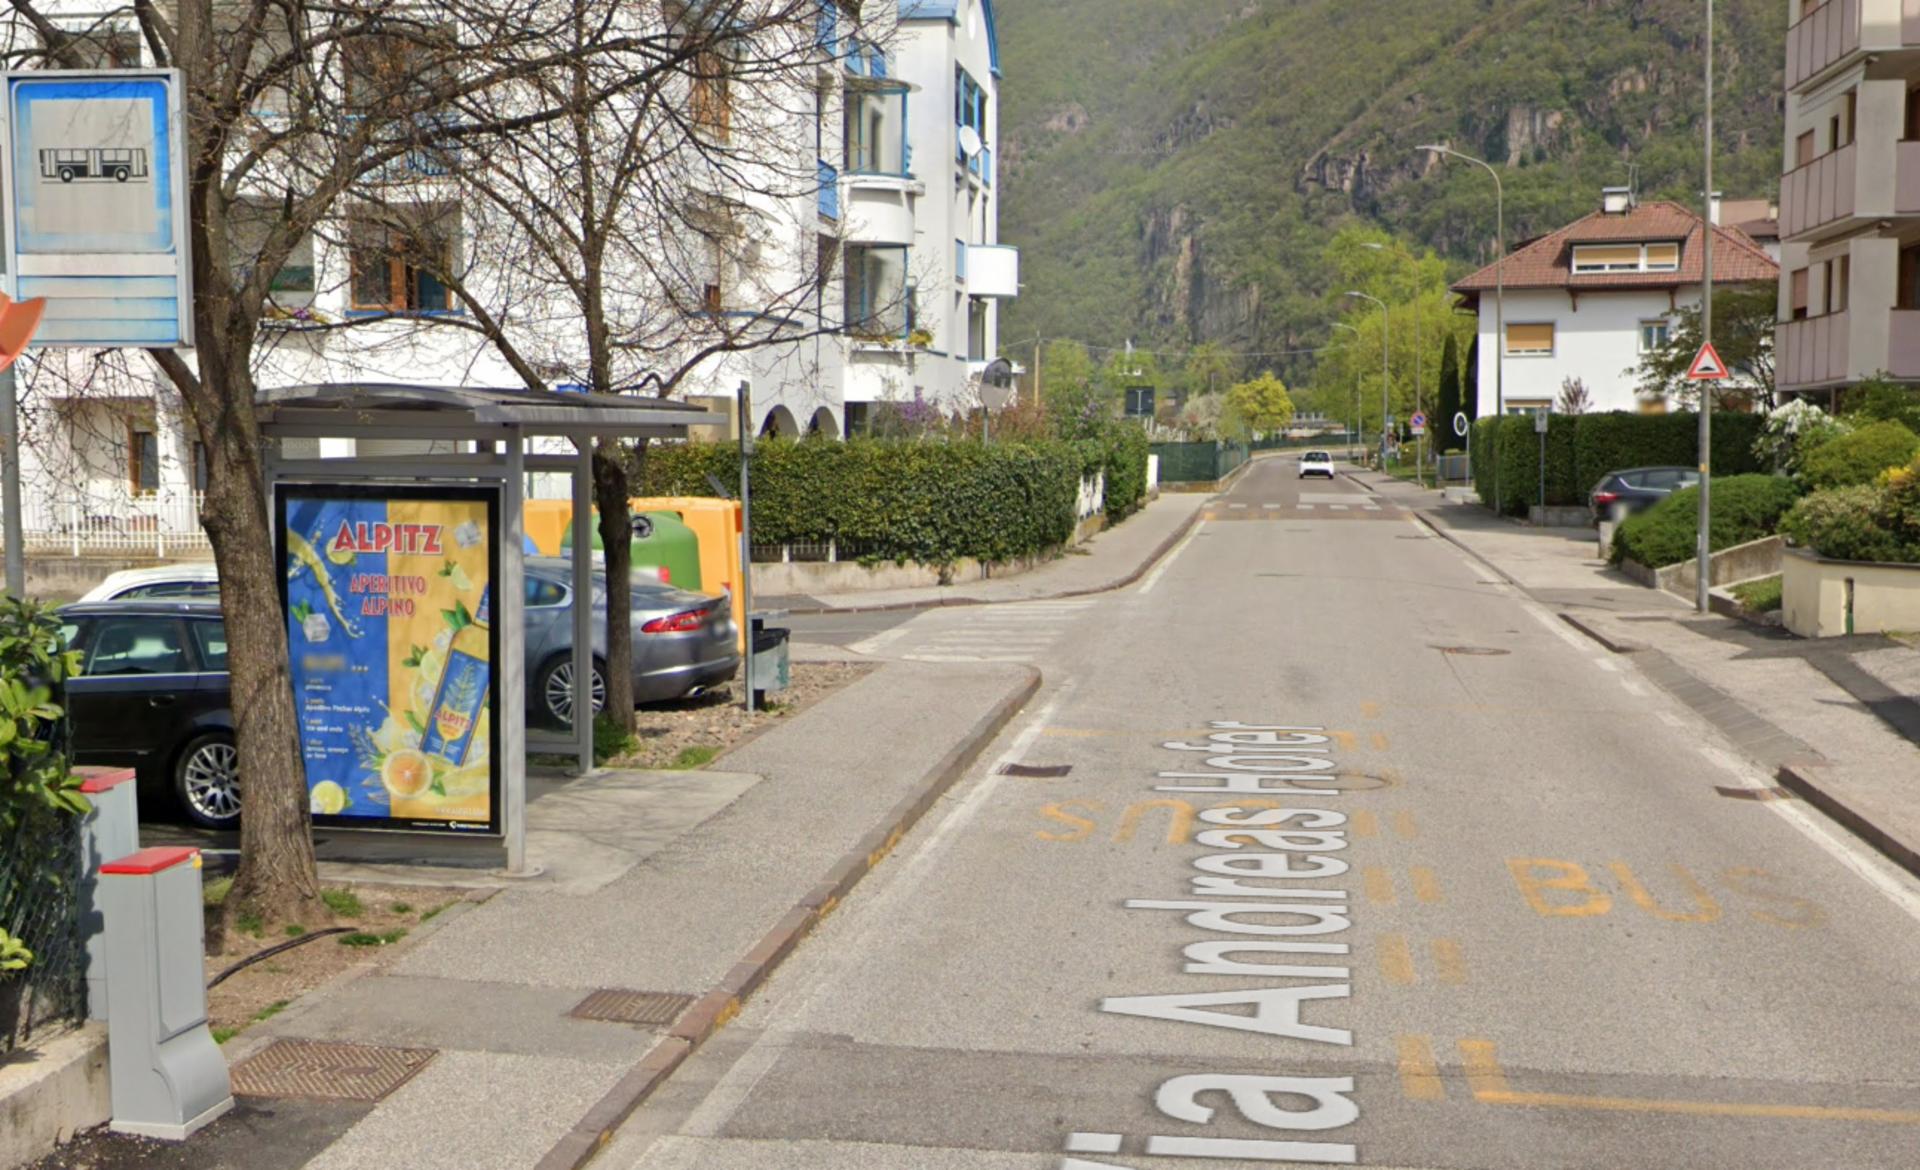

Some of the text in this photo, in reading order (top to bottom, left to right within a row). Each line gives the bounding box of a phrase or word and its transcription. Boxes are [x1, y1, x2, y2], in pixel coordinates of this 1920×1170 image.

[332, 518, 444, 555] ALPITZ
[350, 573, 427, 595] APERITIVO
[361, 595, 416, 616] ALPINO
[1504, 857, 1826, 931] BUS
